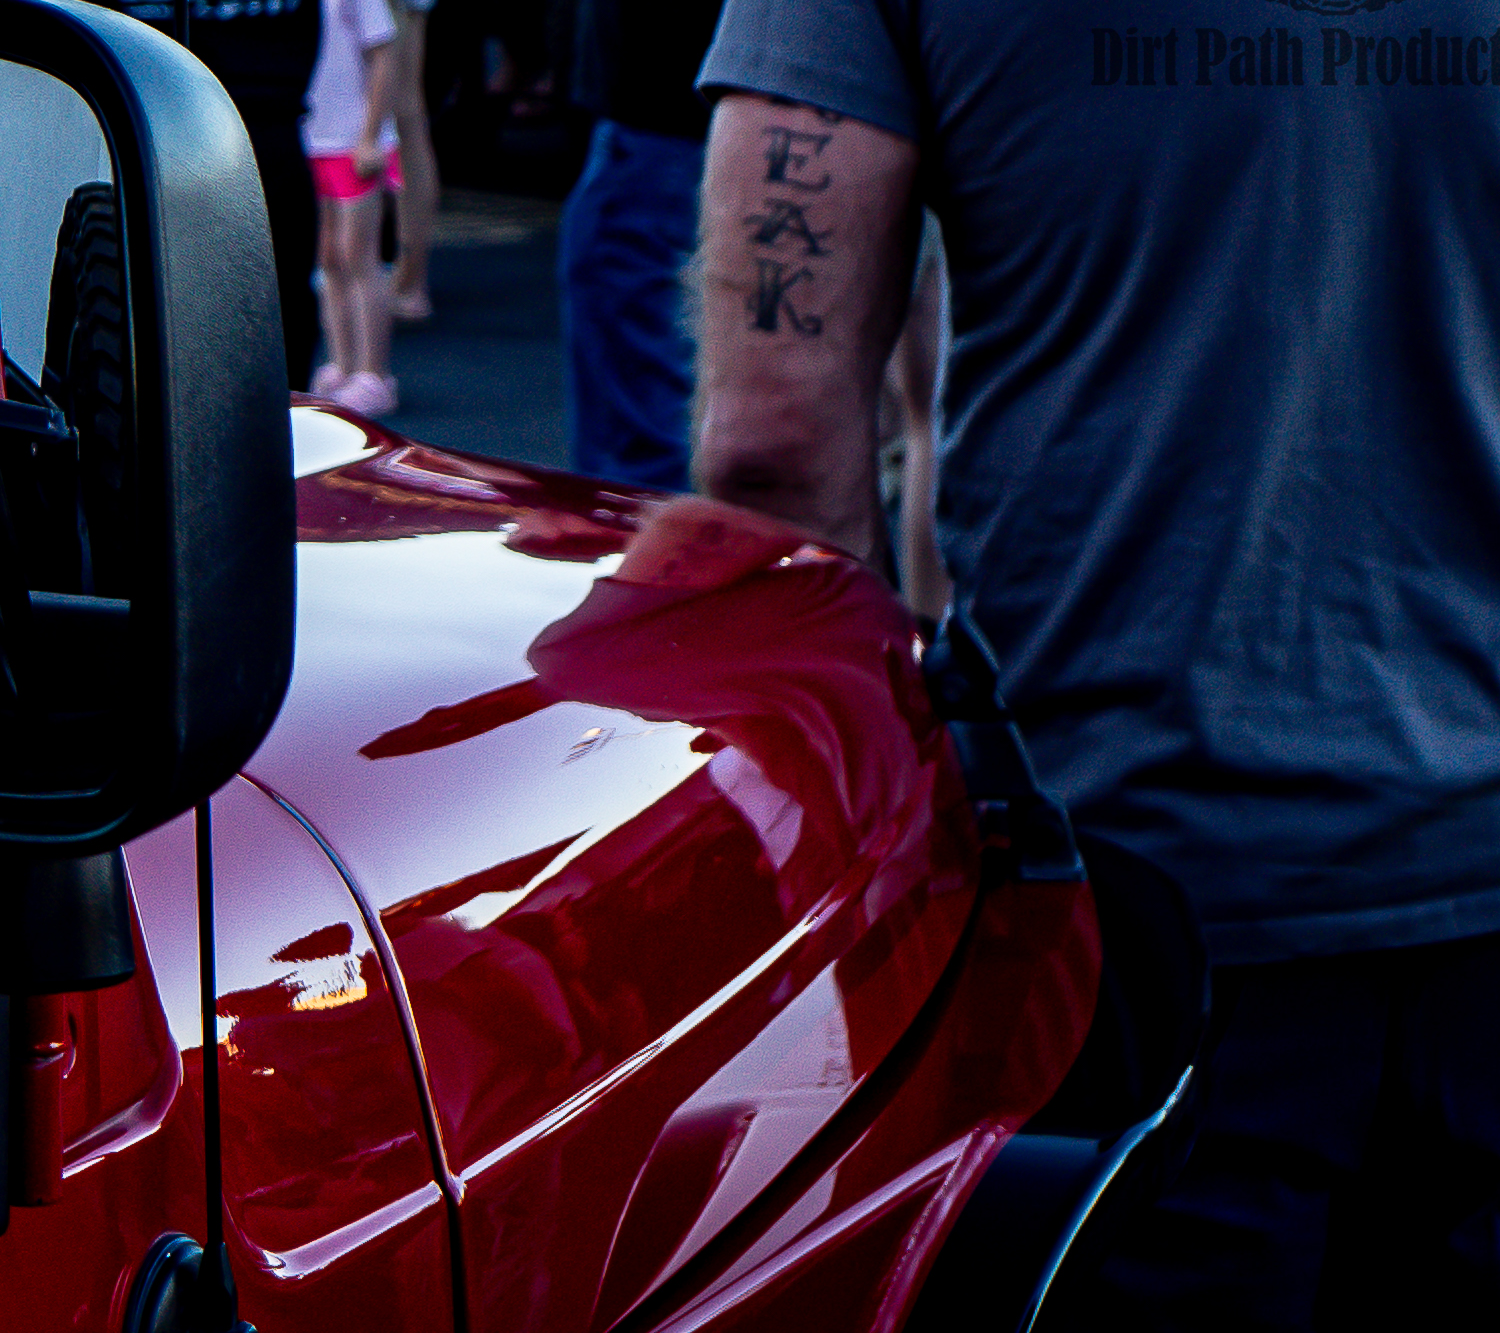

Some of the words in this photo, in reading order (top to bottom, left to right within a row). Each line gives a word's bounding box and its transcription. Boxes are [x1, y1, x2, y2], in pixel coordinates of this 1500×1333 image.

[1088, 27, 1175, 86] Dirt
[1195, 27, 1305, 86] Path
[743, 113, 841, 336] EAK
